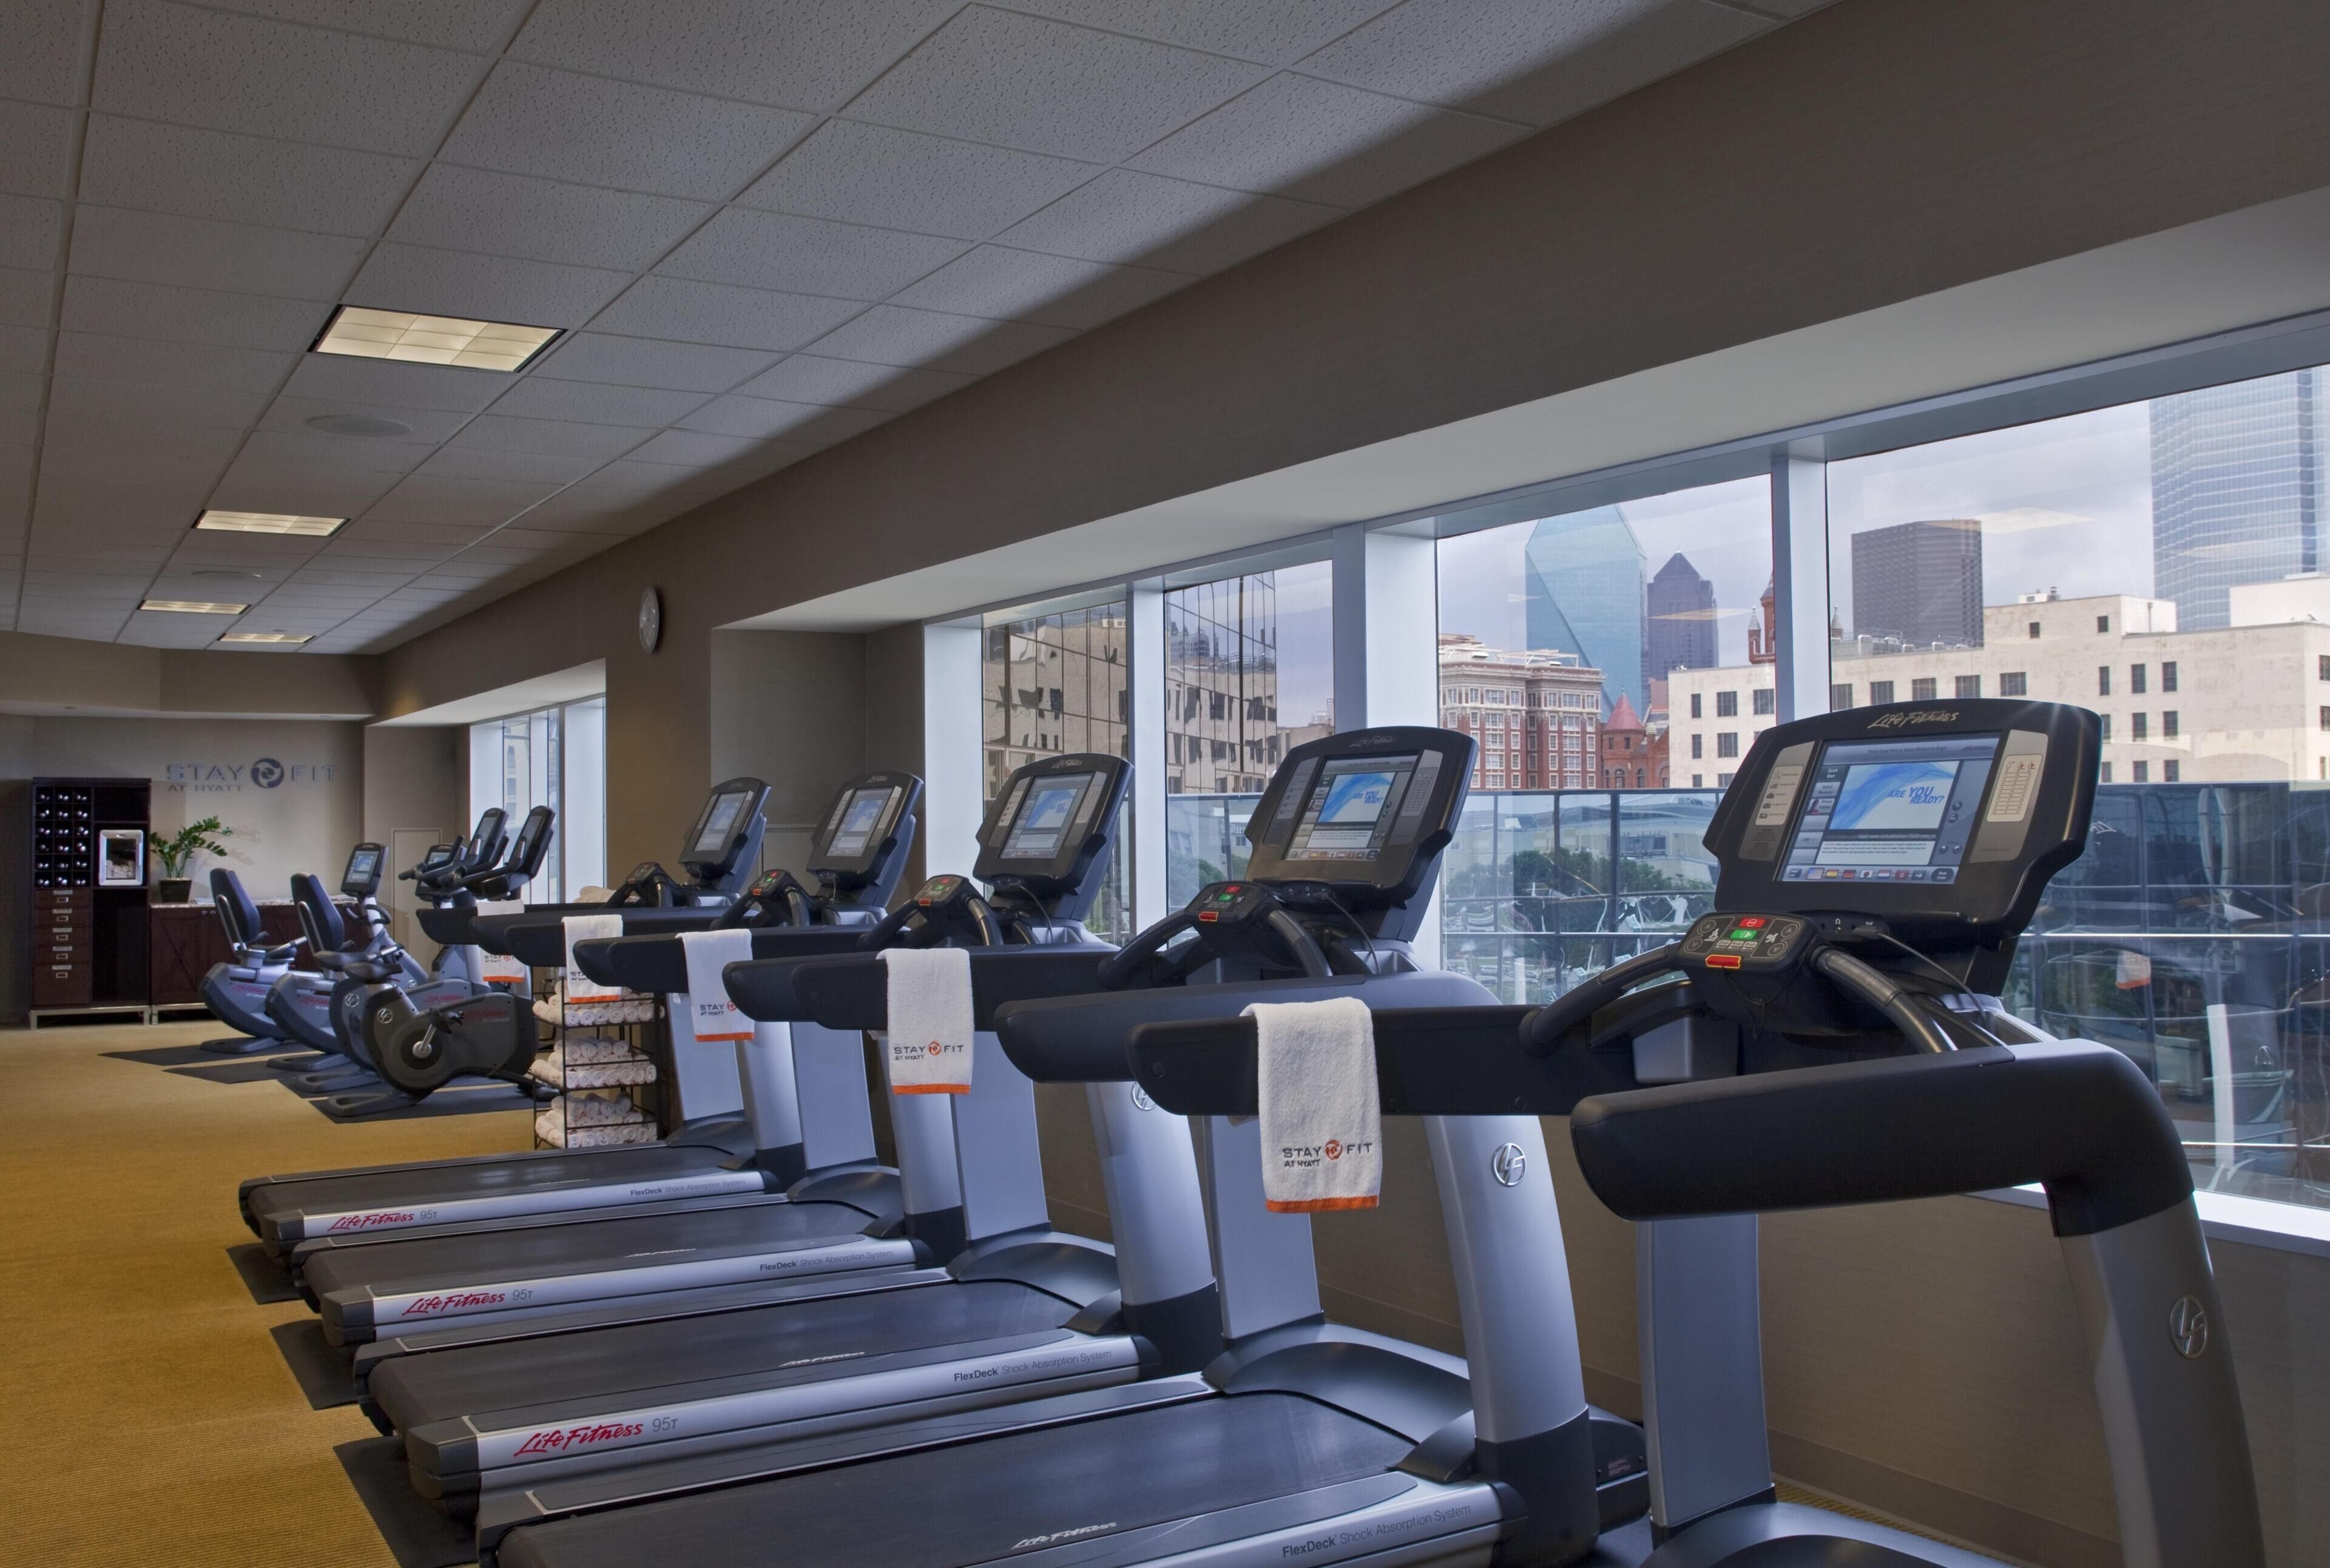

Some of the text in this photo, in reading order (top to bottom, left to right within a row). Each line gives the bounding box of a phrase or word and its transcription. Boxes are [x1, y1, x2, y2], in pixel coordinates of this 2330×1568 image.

[166, 764, 337, 782] STAY FIT
[1887, 786, 1934, 798] ARE YOU
[1910, 796, 1945, 805] READY?
[894, 1046, 926, 1055] STAY
[1282, 1143, 1373, 1158] STAY FIT
[1297, 1159, 1321, 1168] HYATT
[630, 1188, 663, 1196] FlexDeck
[686, 1181, 721, 1192] Absorption
[722, 1178, 745, 1189] System
[760, 1249, 893, 1271] FlexDeck Shock Absorption System
[954, 1350, 1112, 1382] FlexDeck Shock Absorption System
[652, 1416, 678, 1433] 95T
[1282, 1505, 1471, 1558] FlexDeck Shock Absorption System
